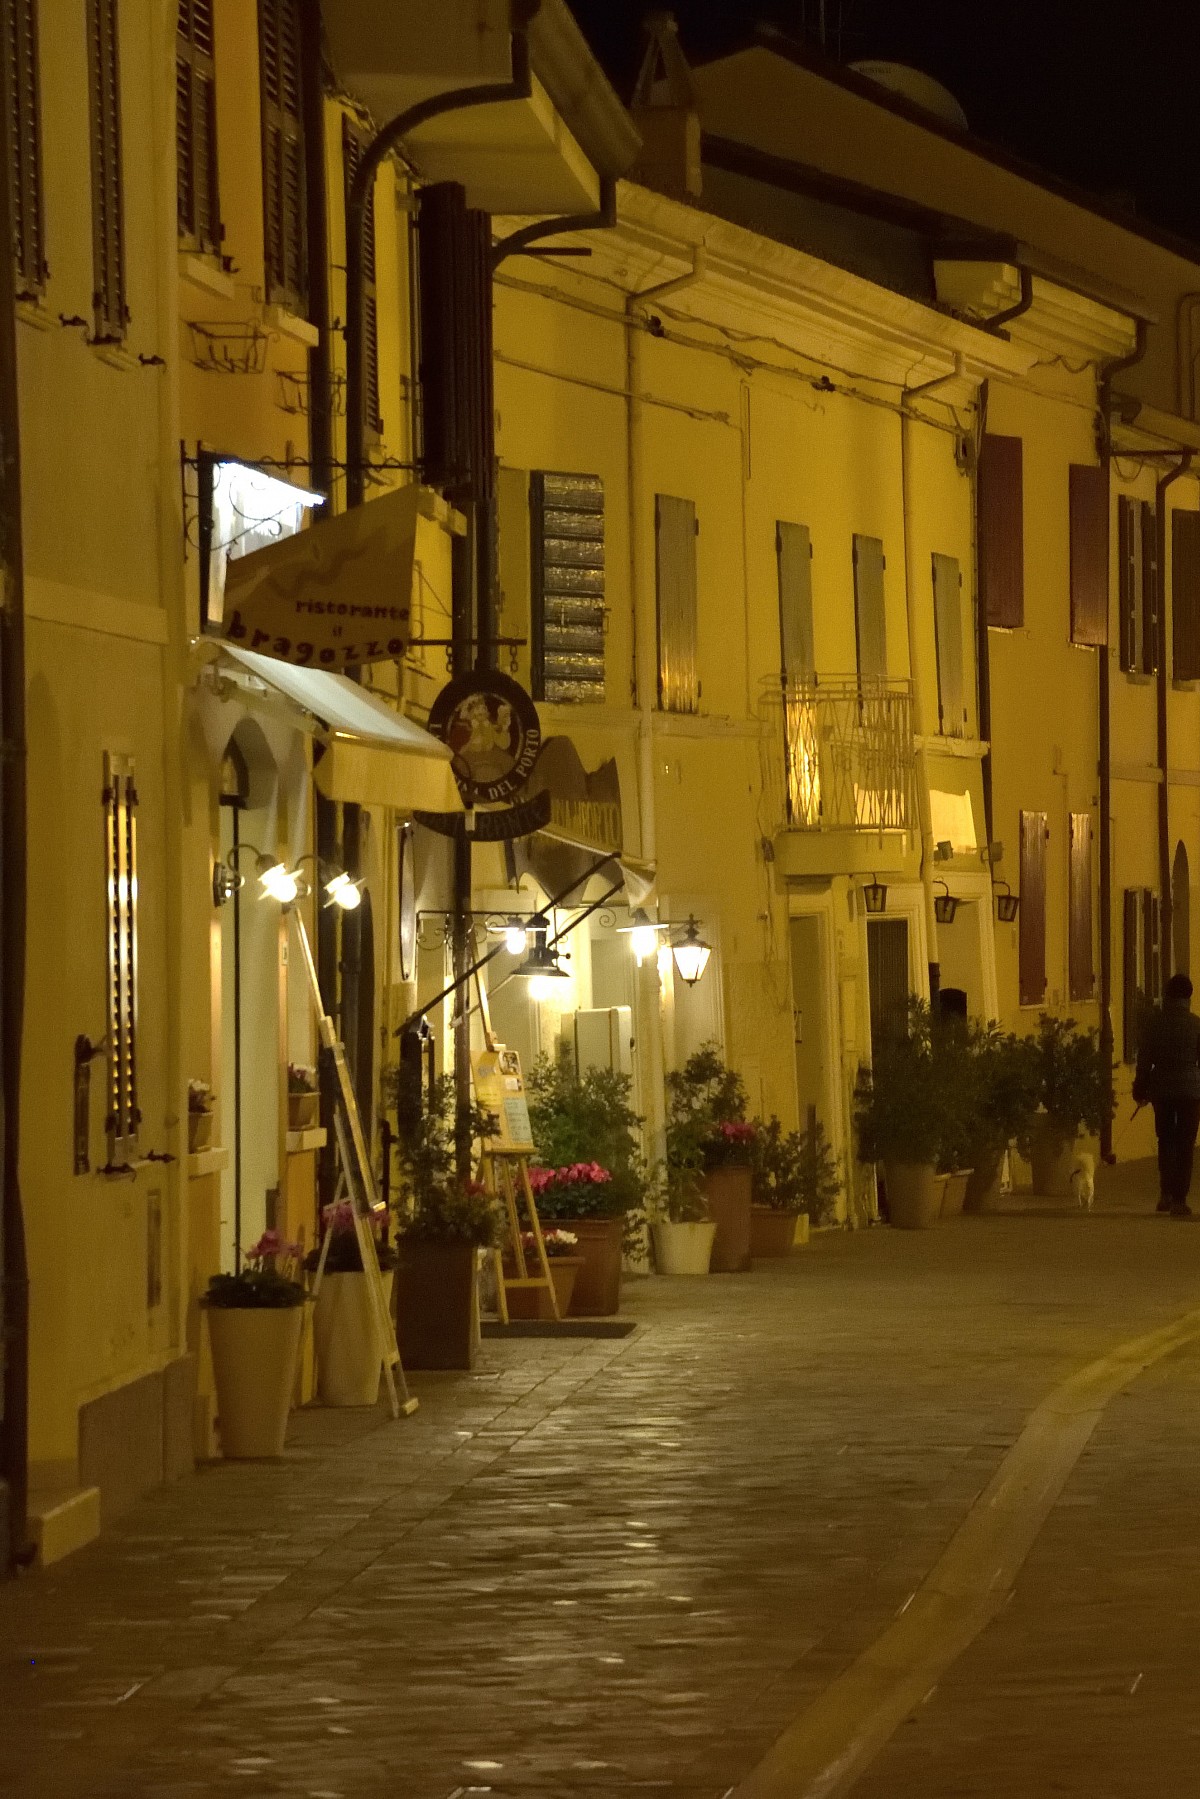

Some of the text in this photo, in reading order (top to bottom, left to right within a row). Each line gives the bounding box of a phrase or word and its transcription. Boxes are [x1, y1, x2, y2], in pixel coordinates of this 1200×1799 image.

[226, 610, 404, 665] bragozzo
[295, 599, 410, 621] ristorante
[487, 779, 518, 800] DEL
[515, 728, 540, 778] PORTO
